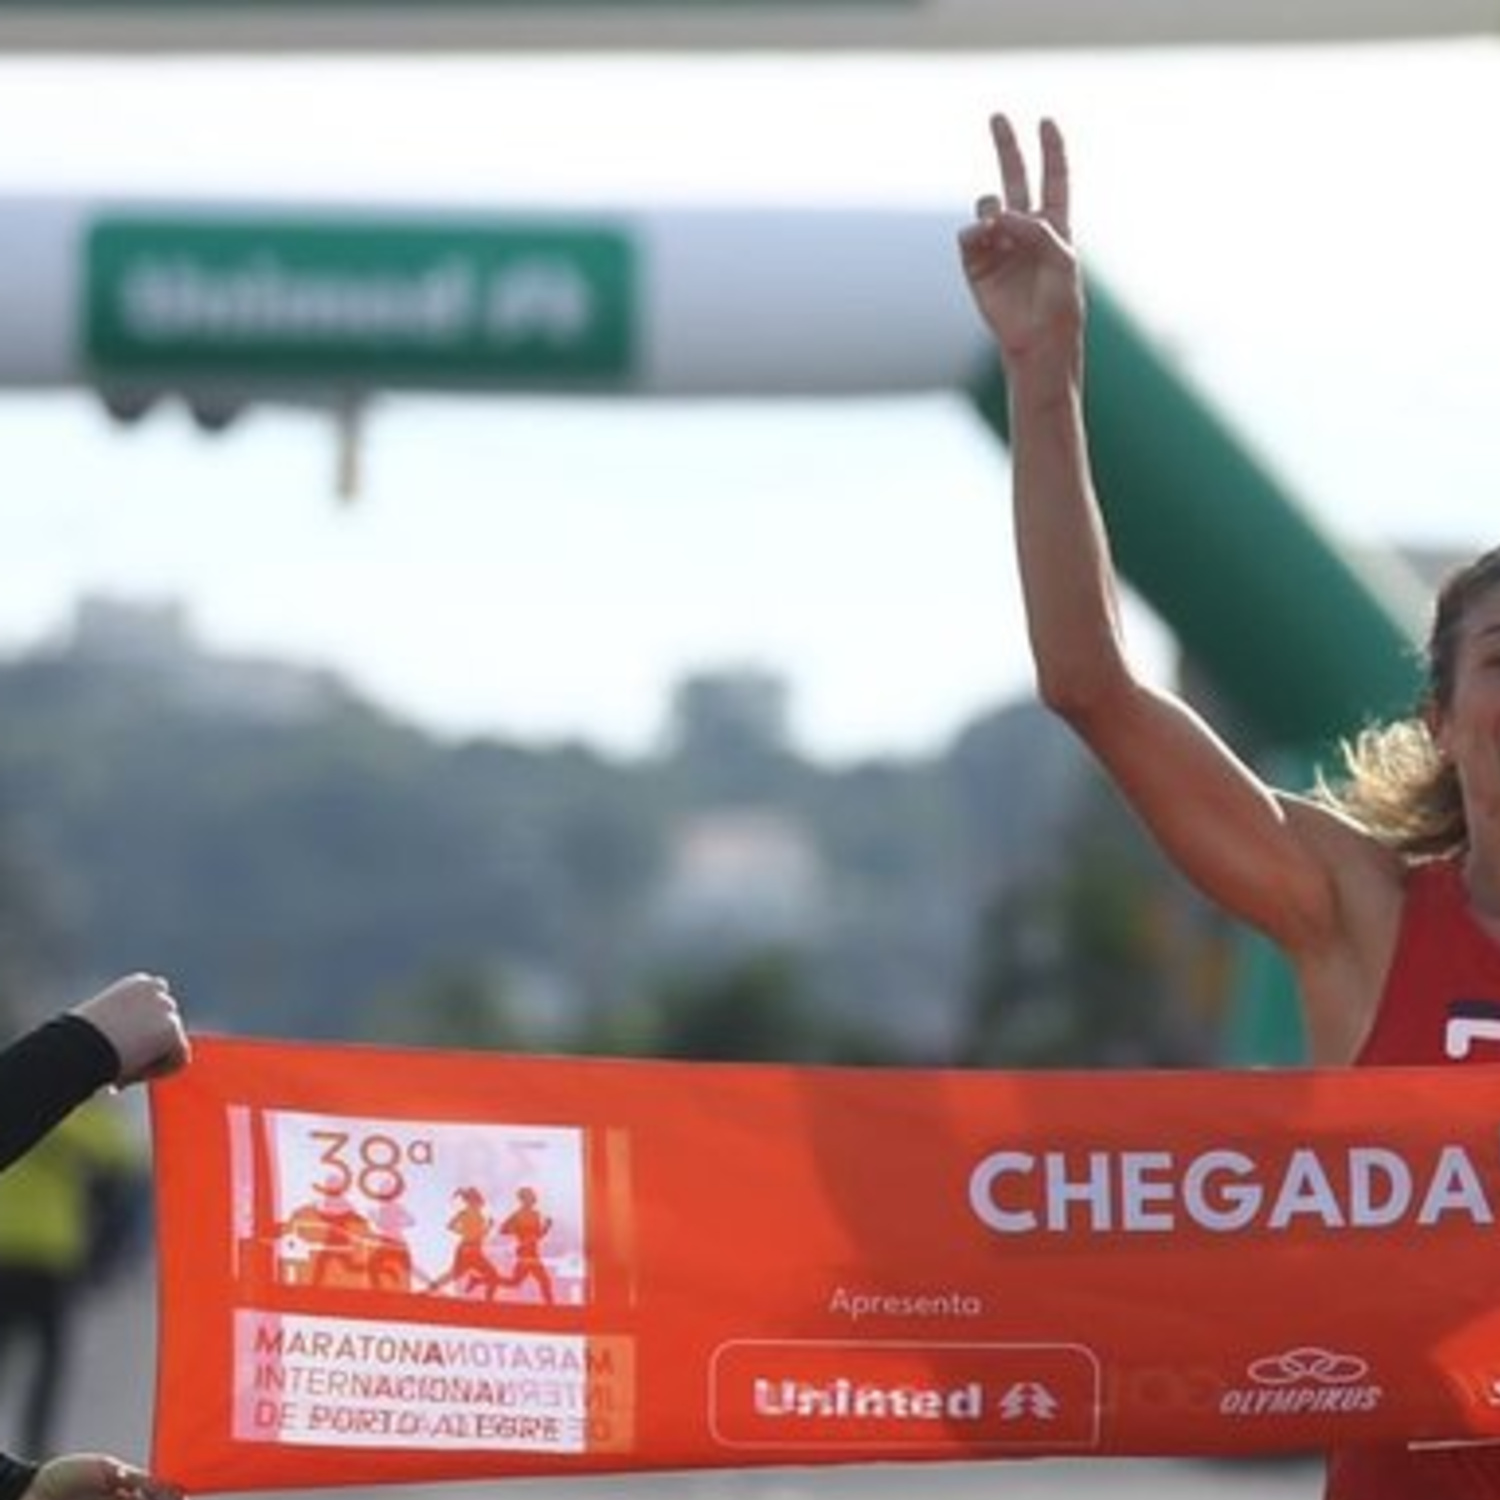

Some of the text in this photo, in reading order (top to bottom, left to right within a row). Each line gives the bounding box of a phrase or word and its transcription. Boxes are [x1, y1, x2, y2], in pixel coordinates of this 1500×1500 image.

[968, 1145, 1495, 1233] CHEGADA
[828, 1287, 982, 1321] Apresenta
[254, 1326, 444, 1367] MARATONA
[254, 1401, 296, 1431] DE
